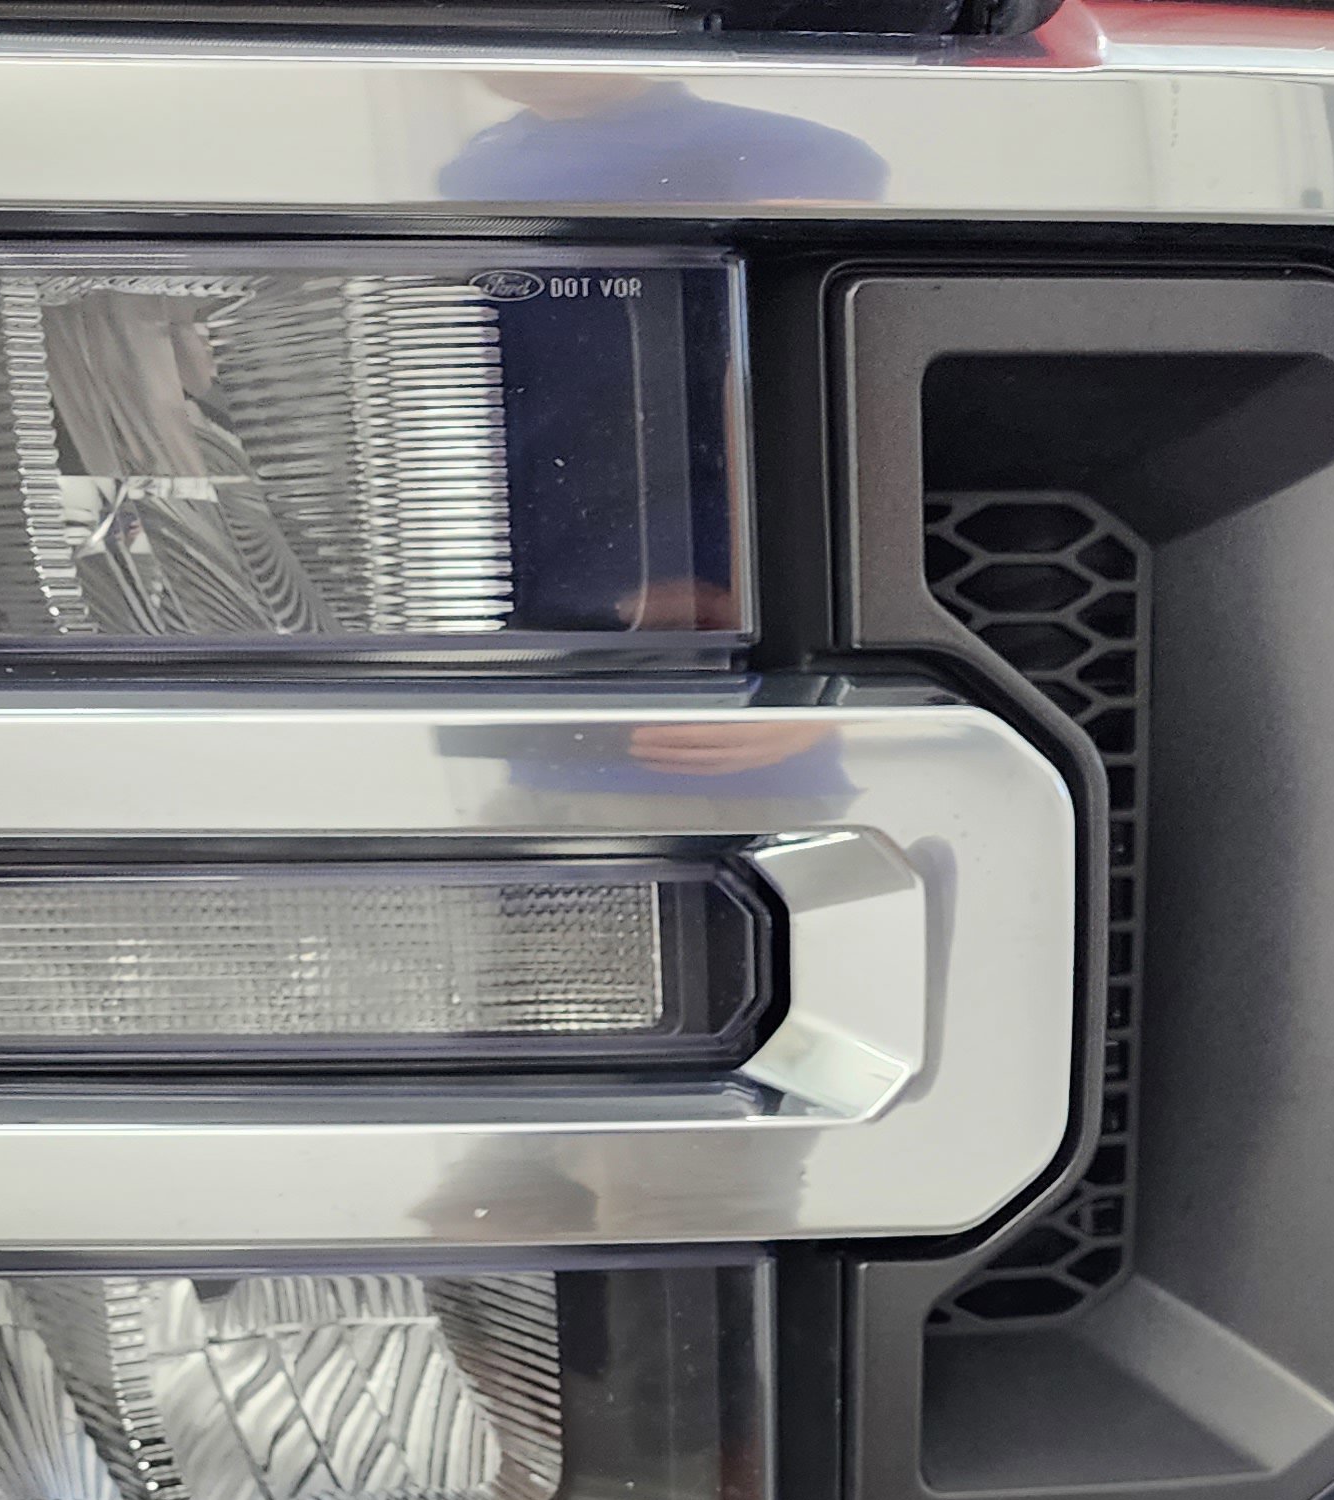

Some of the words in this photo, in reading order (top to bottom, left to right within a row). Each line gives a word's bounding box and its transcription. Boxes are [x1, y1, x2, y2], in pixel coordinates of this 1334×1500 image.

[480, 273, 534, 298] Ford
[549, 277, 590, 298] DOT
[600, 277, 642, 298] VOR
